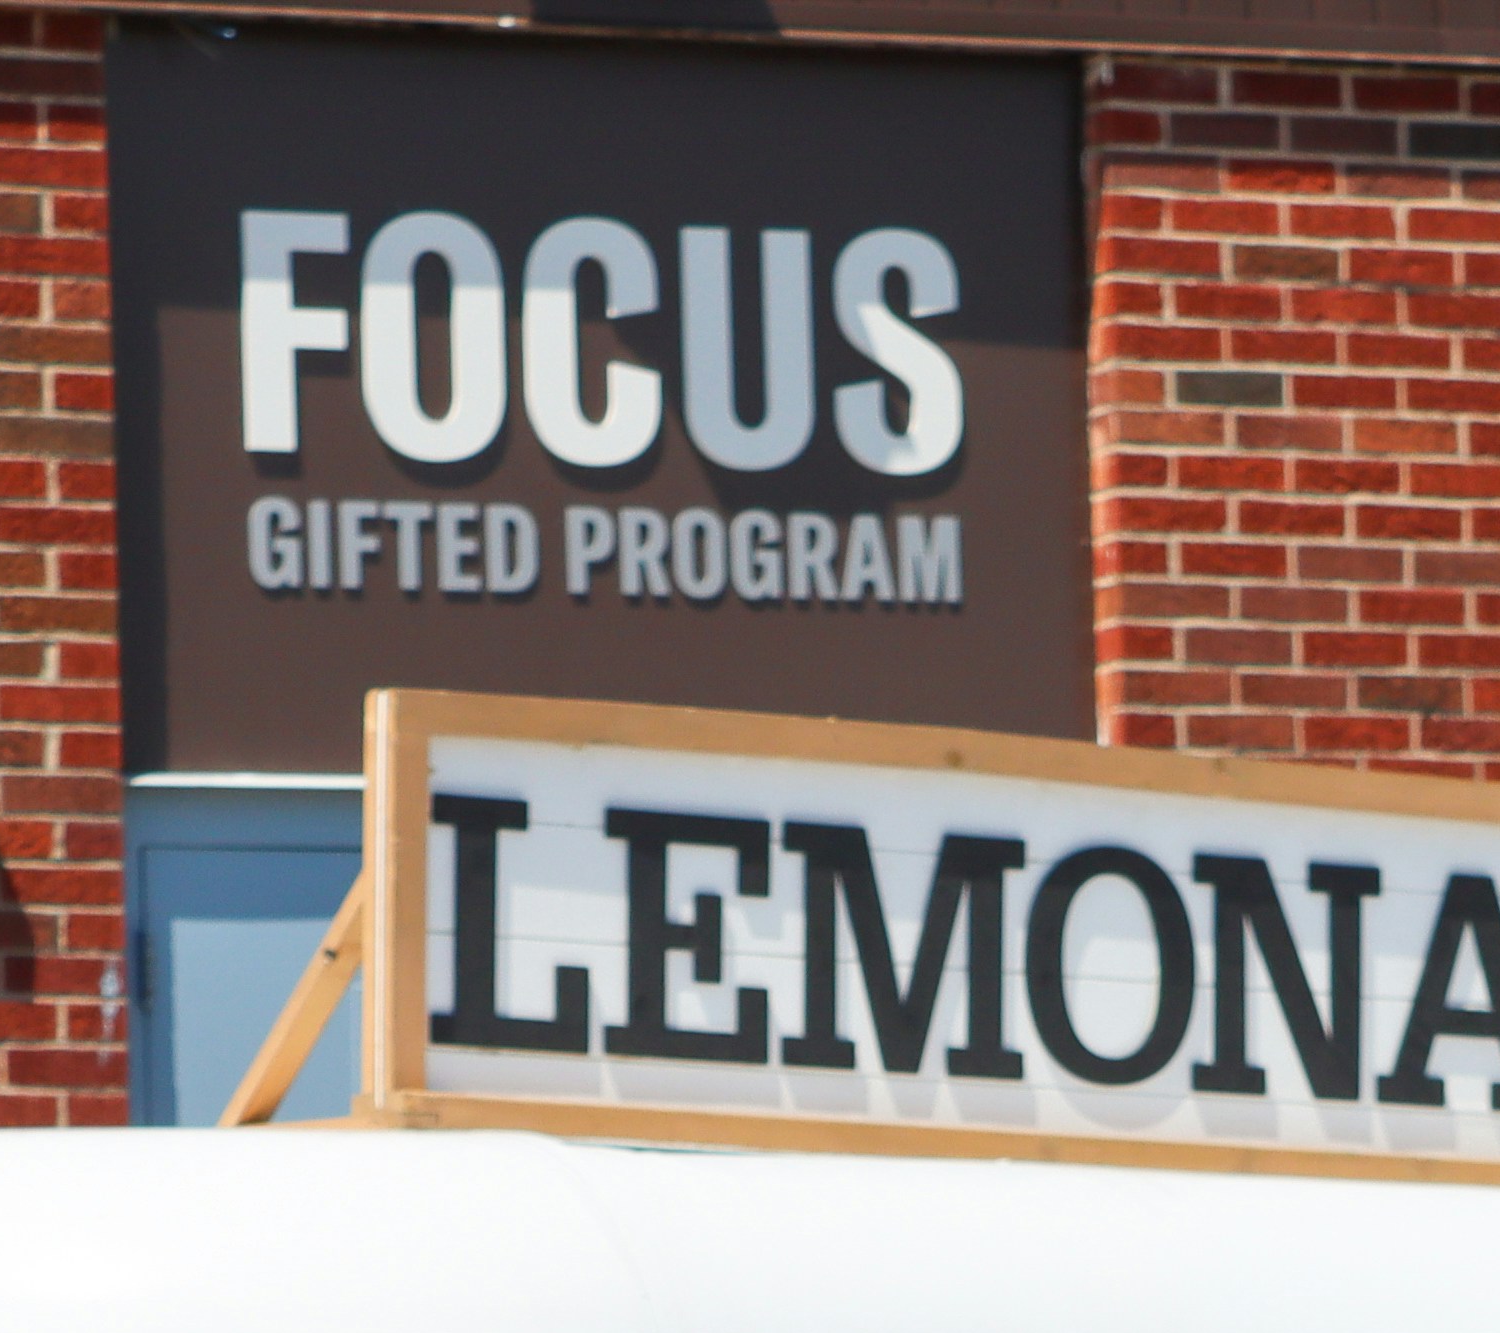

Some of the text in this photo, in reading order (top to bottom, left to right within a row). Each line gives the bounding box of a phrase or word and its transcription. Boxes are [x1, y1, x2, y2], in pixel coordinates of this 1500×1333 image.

[240, 209, 964, 475] FOCUS
[246, 495, 964, 605] GIFTED PROGRAM
